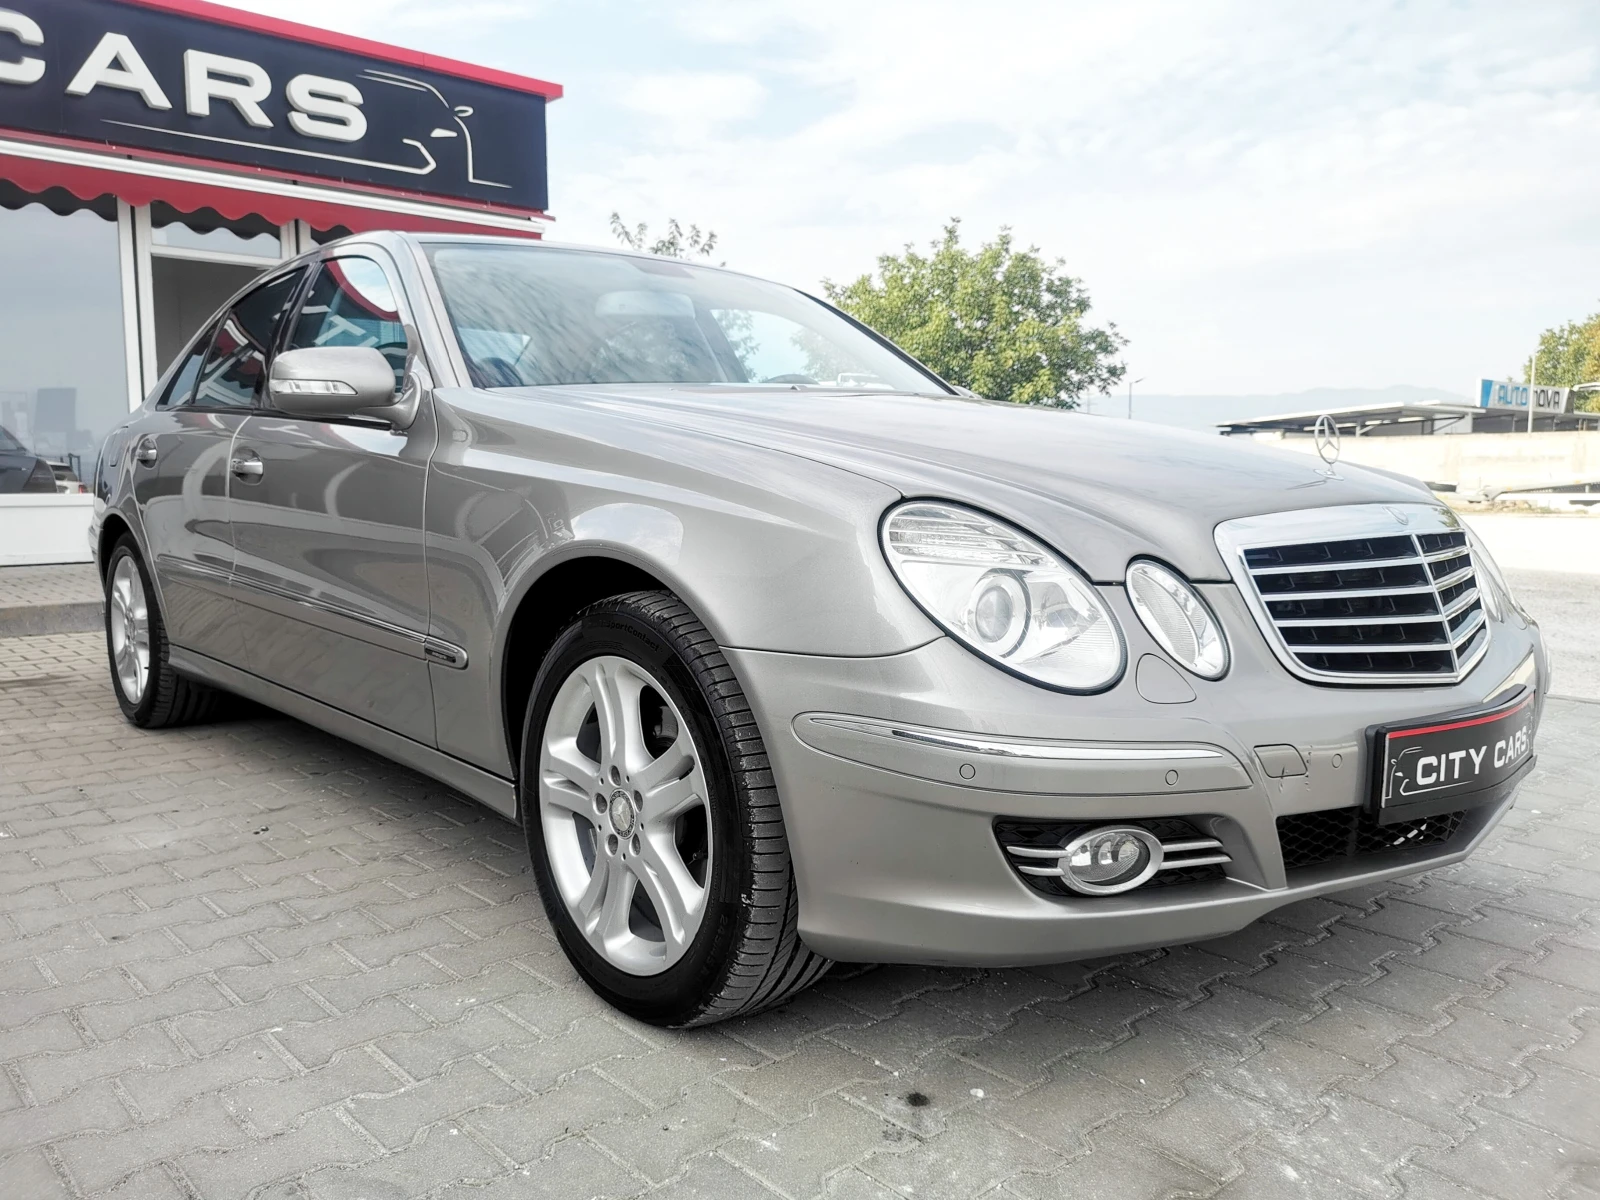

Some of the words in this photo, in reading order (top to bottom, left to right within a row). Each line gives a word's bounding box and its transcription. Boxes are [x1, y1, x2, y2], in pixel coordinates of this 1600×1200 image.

[1498, 385, 1528, 405] AUTO
[1416, 746, 1487, 786] CITY
[1494, 725, 1528, 769] CARS
